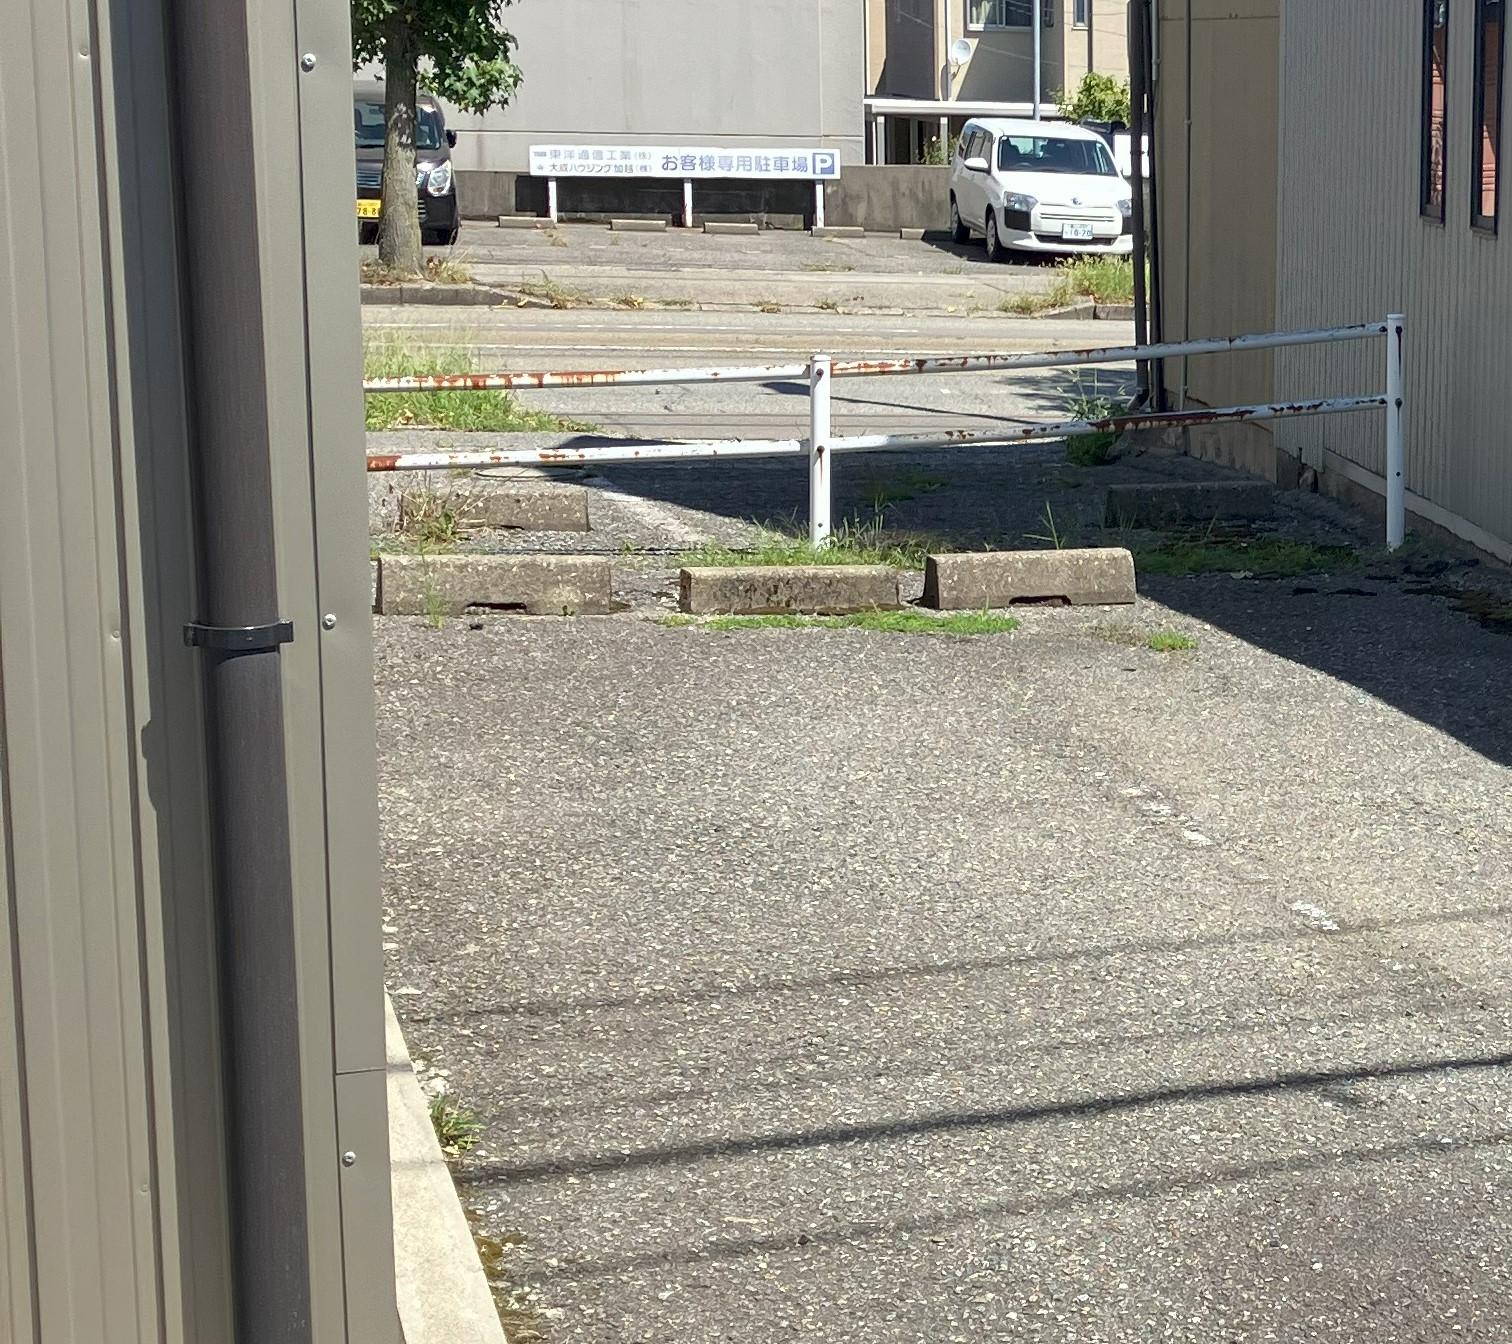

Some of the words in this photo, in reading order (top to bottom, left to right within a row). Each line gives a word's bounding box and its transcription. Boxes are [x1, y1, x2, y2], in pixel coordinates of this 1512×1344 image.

[661, 154, 808, 173] お客様専用駐車場
[814, 153, 834, 174] P
